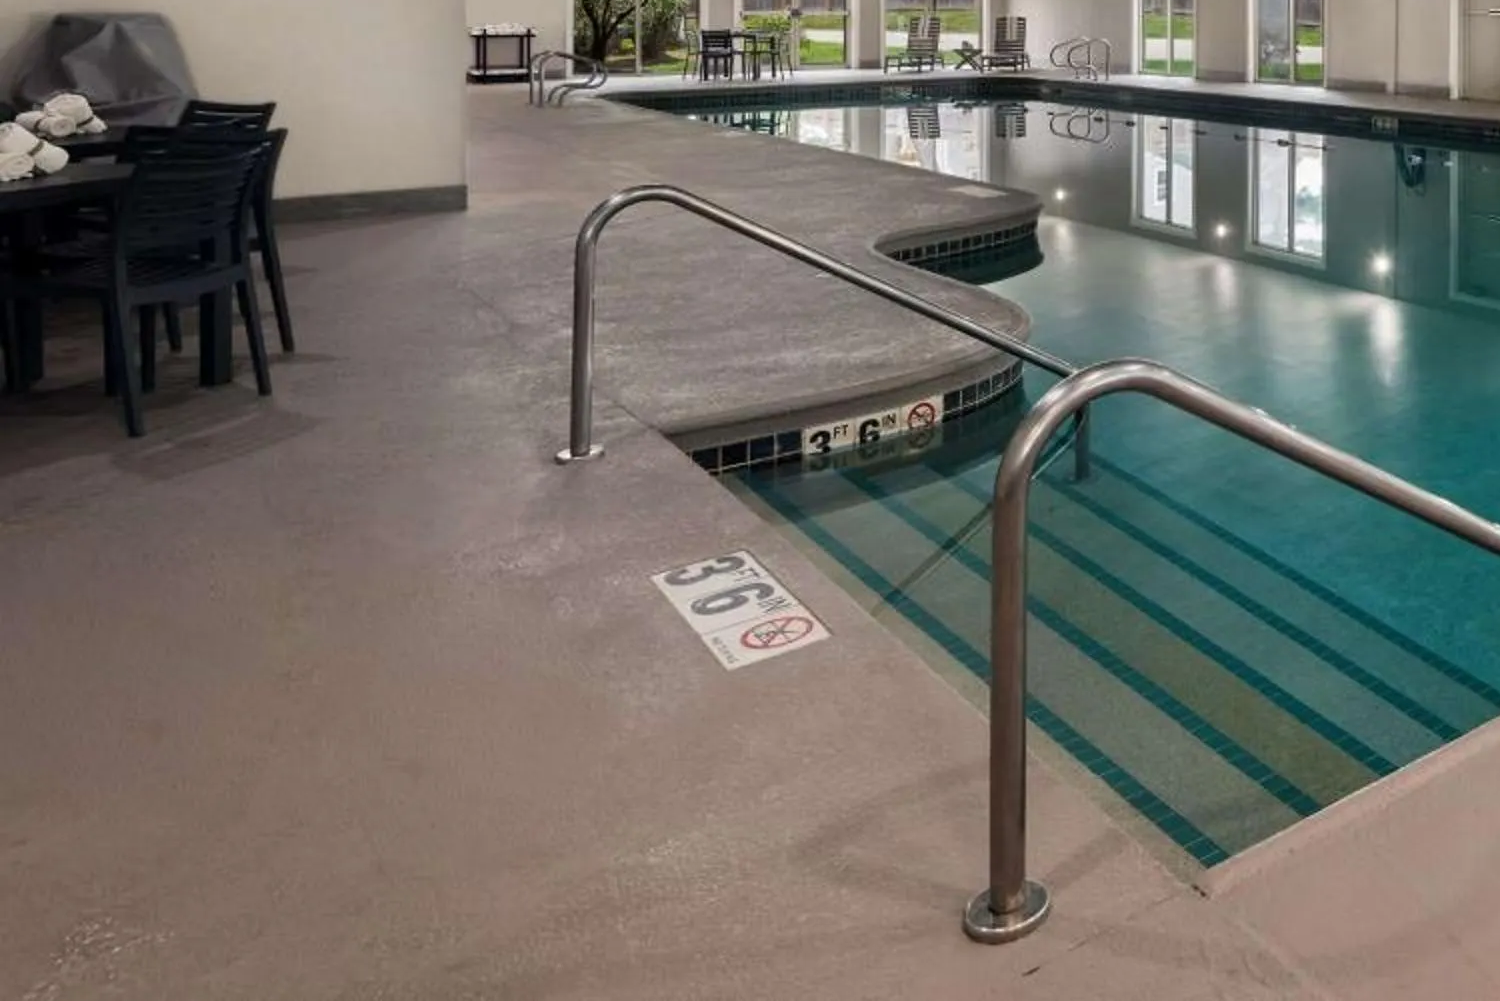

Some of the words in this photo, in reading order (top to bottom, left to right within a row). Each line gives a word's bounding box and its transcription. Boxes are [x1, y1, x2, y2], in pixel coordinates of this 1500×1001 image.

[809, 430, 831, 454] 3
[833, 424, 849, 439] FT
[859, 418, 880, 444] 6
[881, 413, 897, 428] IN
[664, 556, 745, 585] 3
[690, 582, 775, 615] 6
